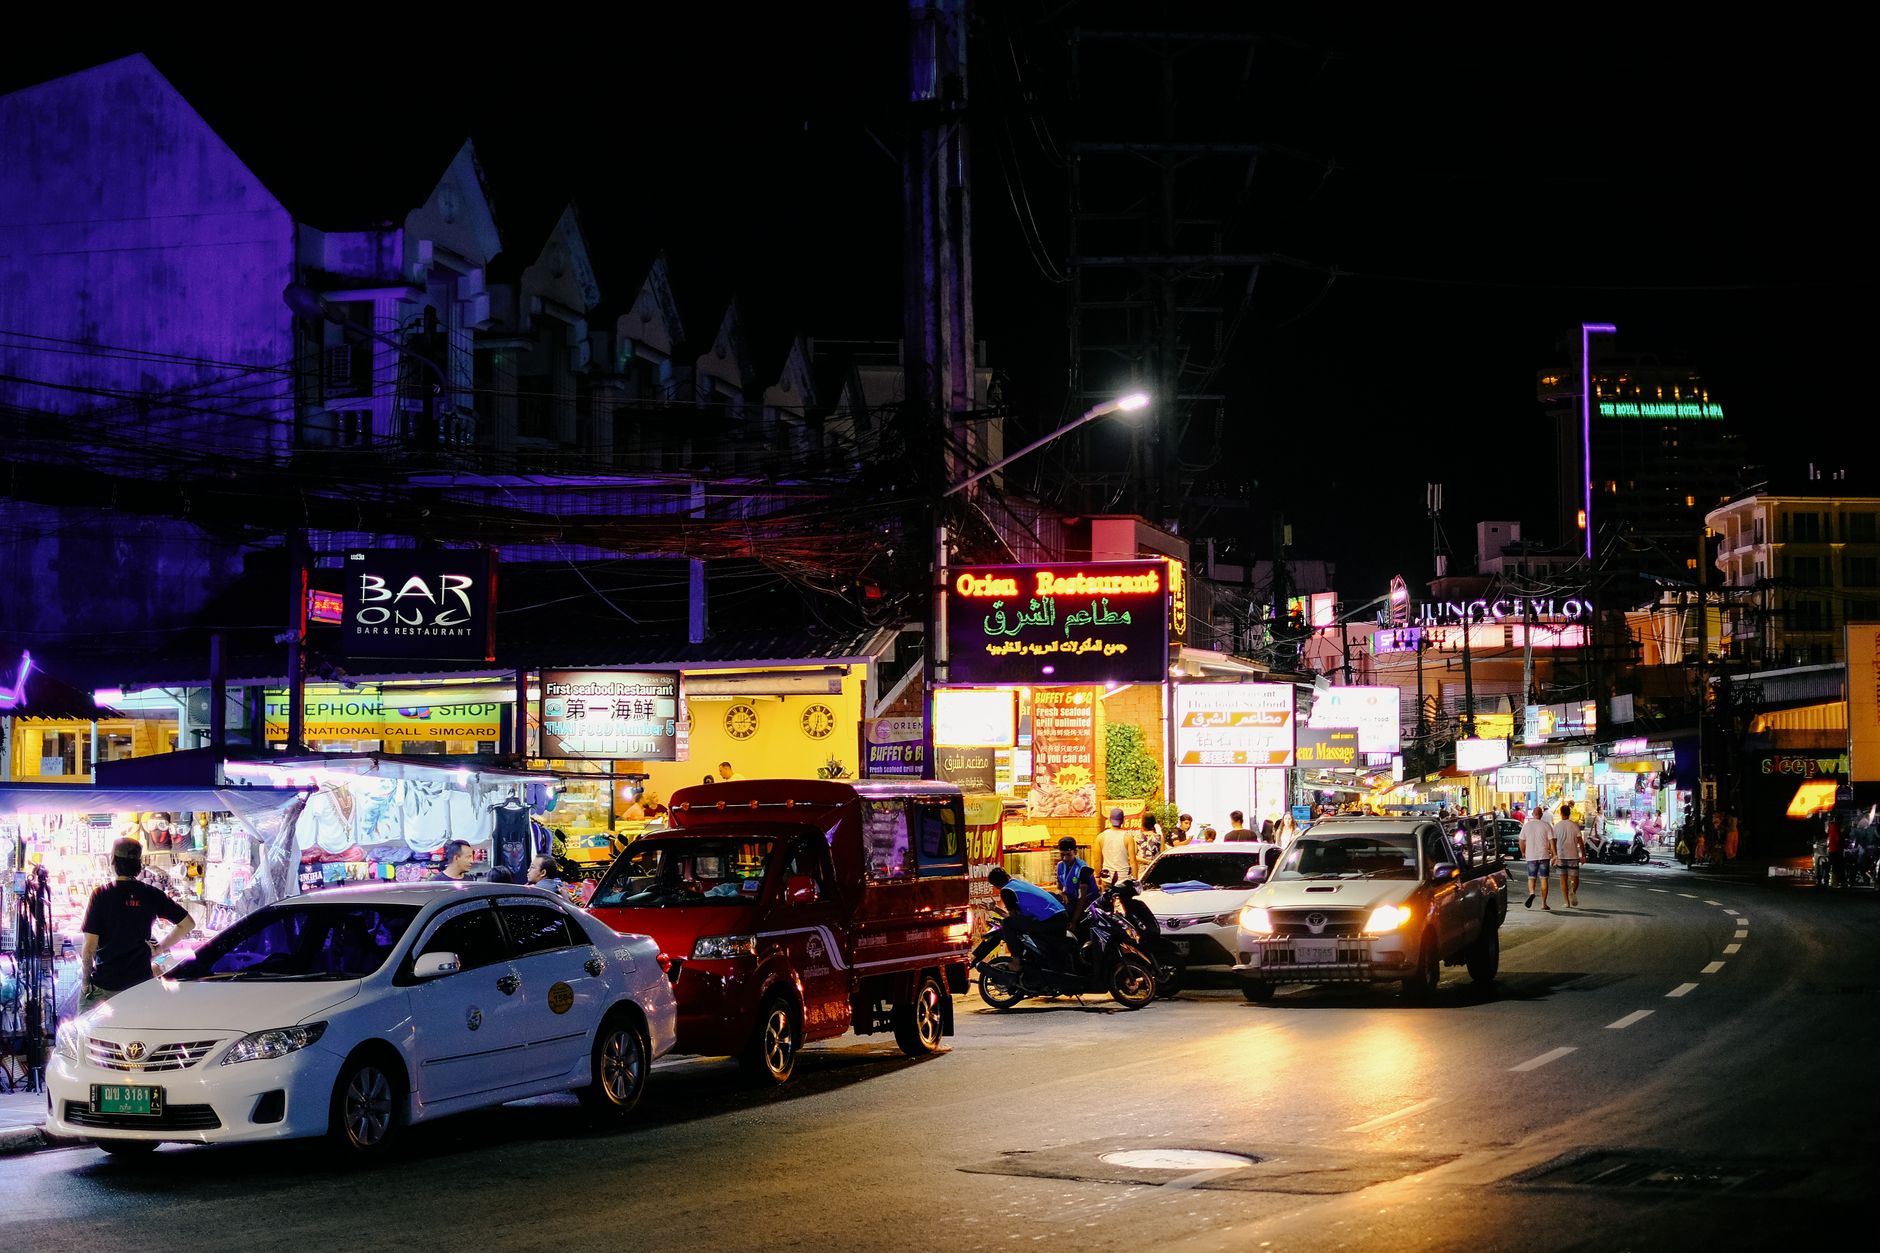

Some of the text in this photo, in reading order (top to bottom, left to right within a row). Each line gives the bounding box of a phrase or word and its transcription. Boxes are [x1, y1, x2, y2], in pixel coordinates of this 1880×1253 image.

[1600, 403, 1614, 415] THE
[1616, 403, 1639, 416] ROYAL
[1640, 403, 1677, 416] PARADISE
[1677, 404, 1701, 416] HOTEL
[1709, 404, 1723, 417] SPA
[956, 570, 1160, 597] Orien Restaurant
[359, 573, 473, 617] BAR
[356, 627, 472, 636] BAR & RESTAURANT
[546, 682, 674, 695] First seafood Restaurant
[1034, 692, 1065, 704] BUFFET
[1065, 692, 1072, 704] &
[266, 703, 497, 716] TEEPHONE SHOP
[566, 698, 656, 720] 第一海鮮
[1036, 707, 1059, 717] Fresh
[266, 727, 497, 736] INTRNATIONAL CALL SIMCARD
[665, 720, 675, 736] 5
[870, 745, 904, 762] BUFFET
[904, 745, 913, 761] &
[1047, 754, 1061, 764] you
[1062, 754, 1077, 763] can
[1296, 743, 1355, 764] enz Massage
[1499, 775, 1533, 785] TATTOO
[124, 1088, 149, 1101] 3181
